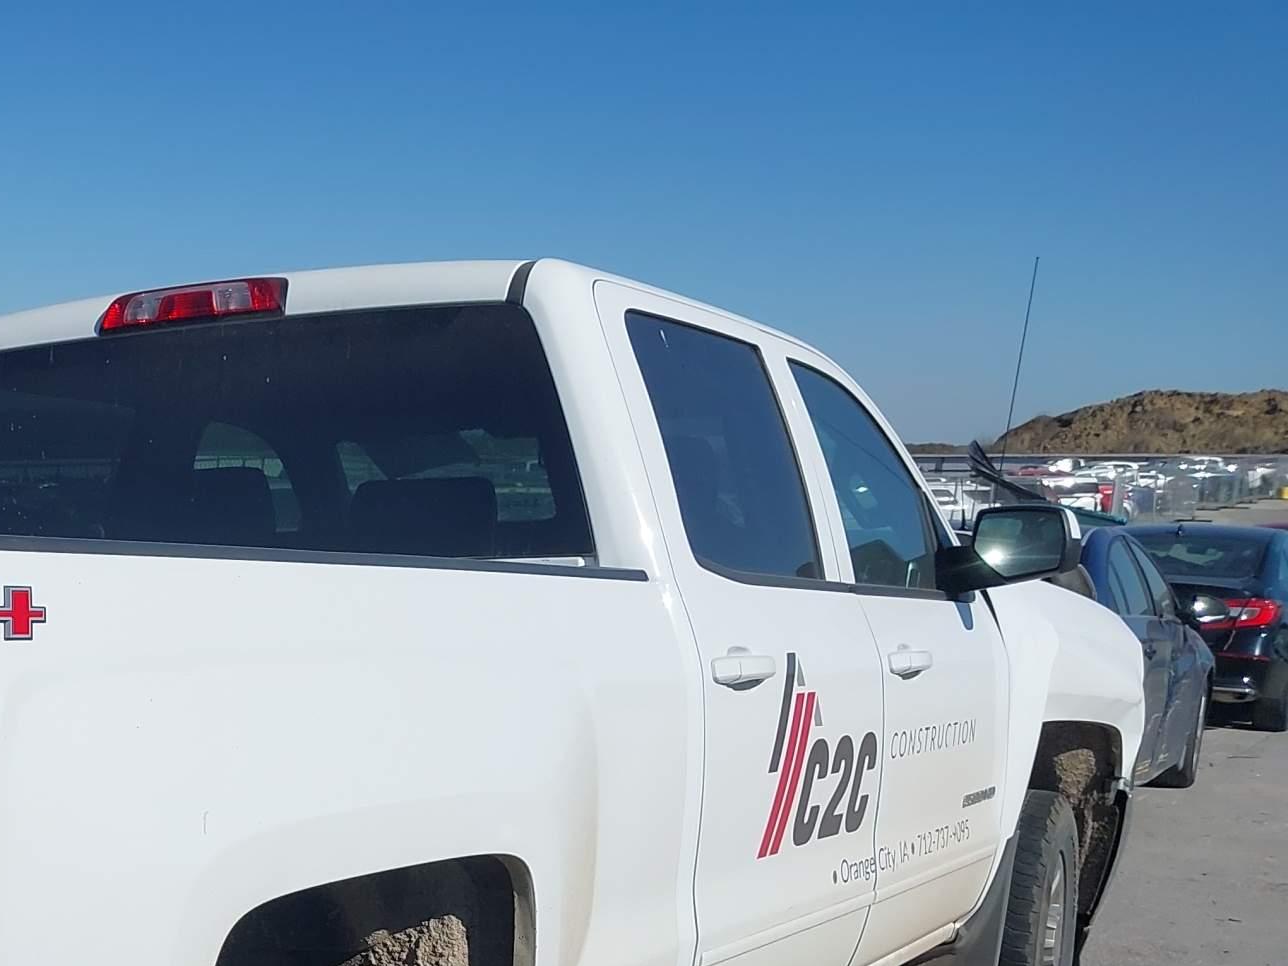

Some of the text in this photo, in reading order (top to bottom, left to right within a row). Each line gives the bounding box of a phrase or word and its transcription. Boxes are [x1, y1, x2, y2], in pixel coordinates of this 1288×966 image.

[793, 718, 976, 846] C2C CONSTRUCTION
[841, 857, 875, 883] Orange
[899, 839, 910, 863] IA
